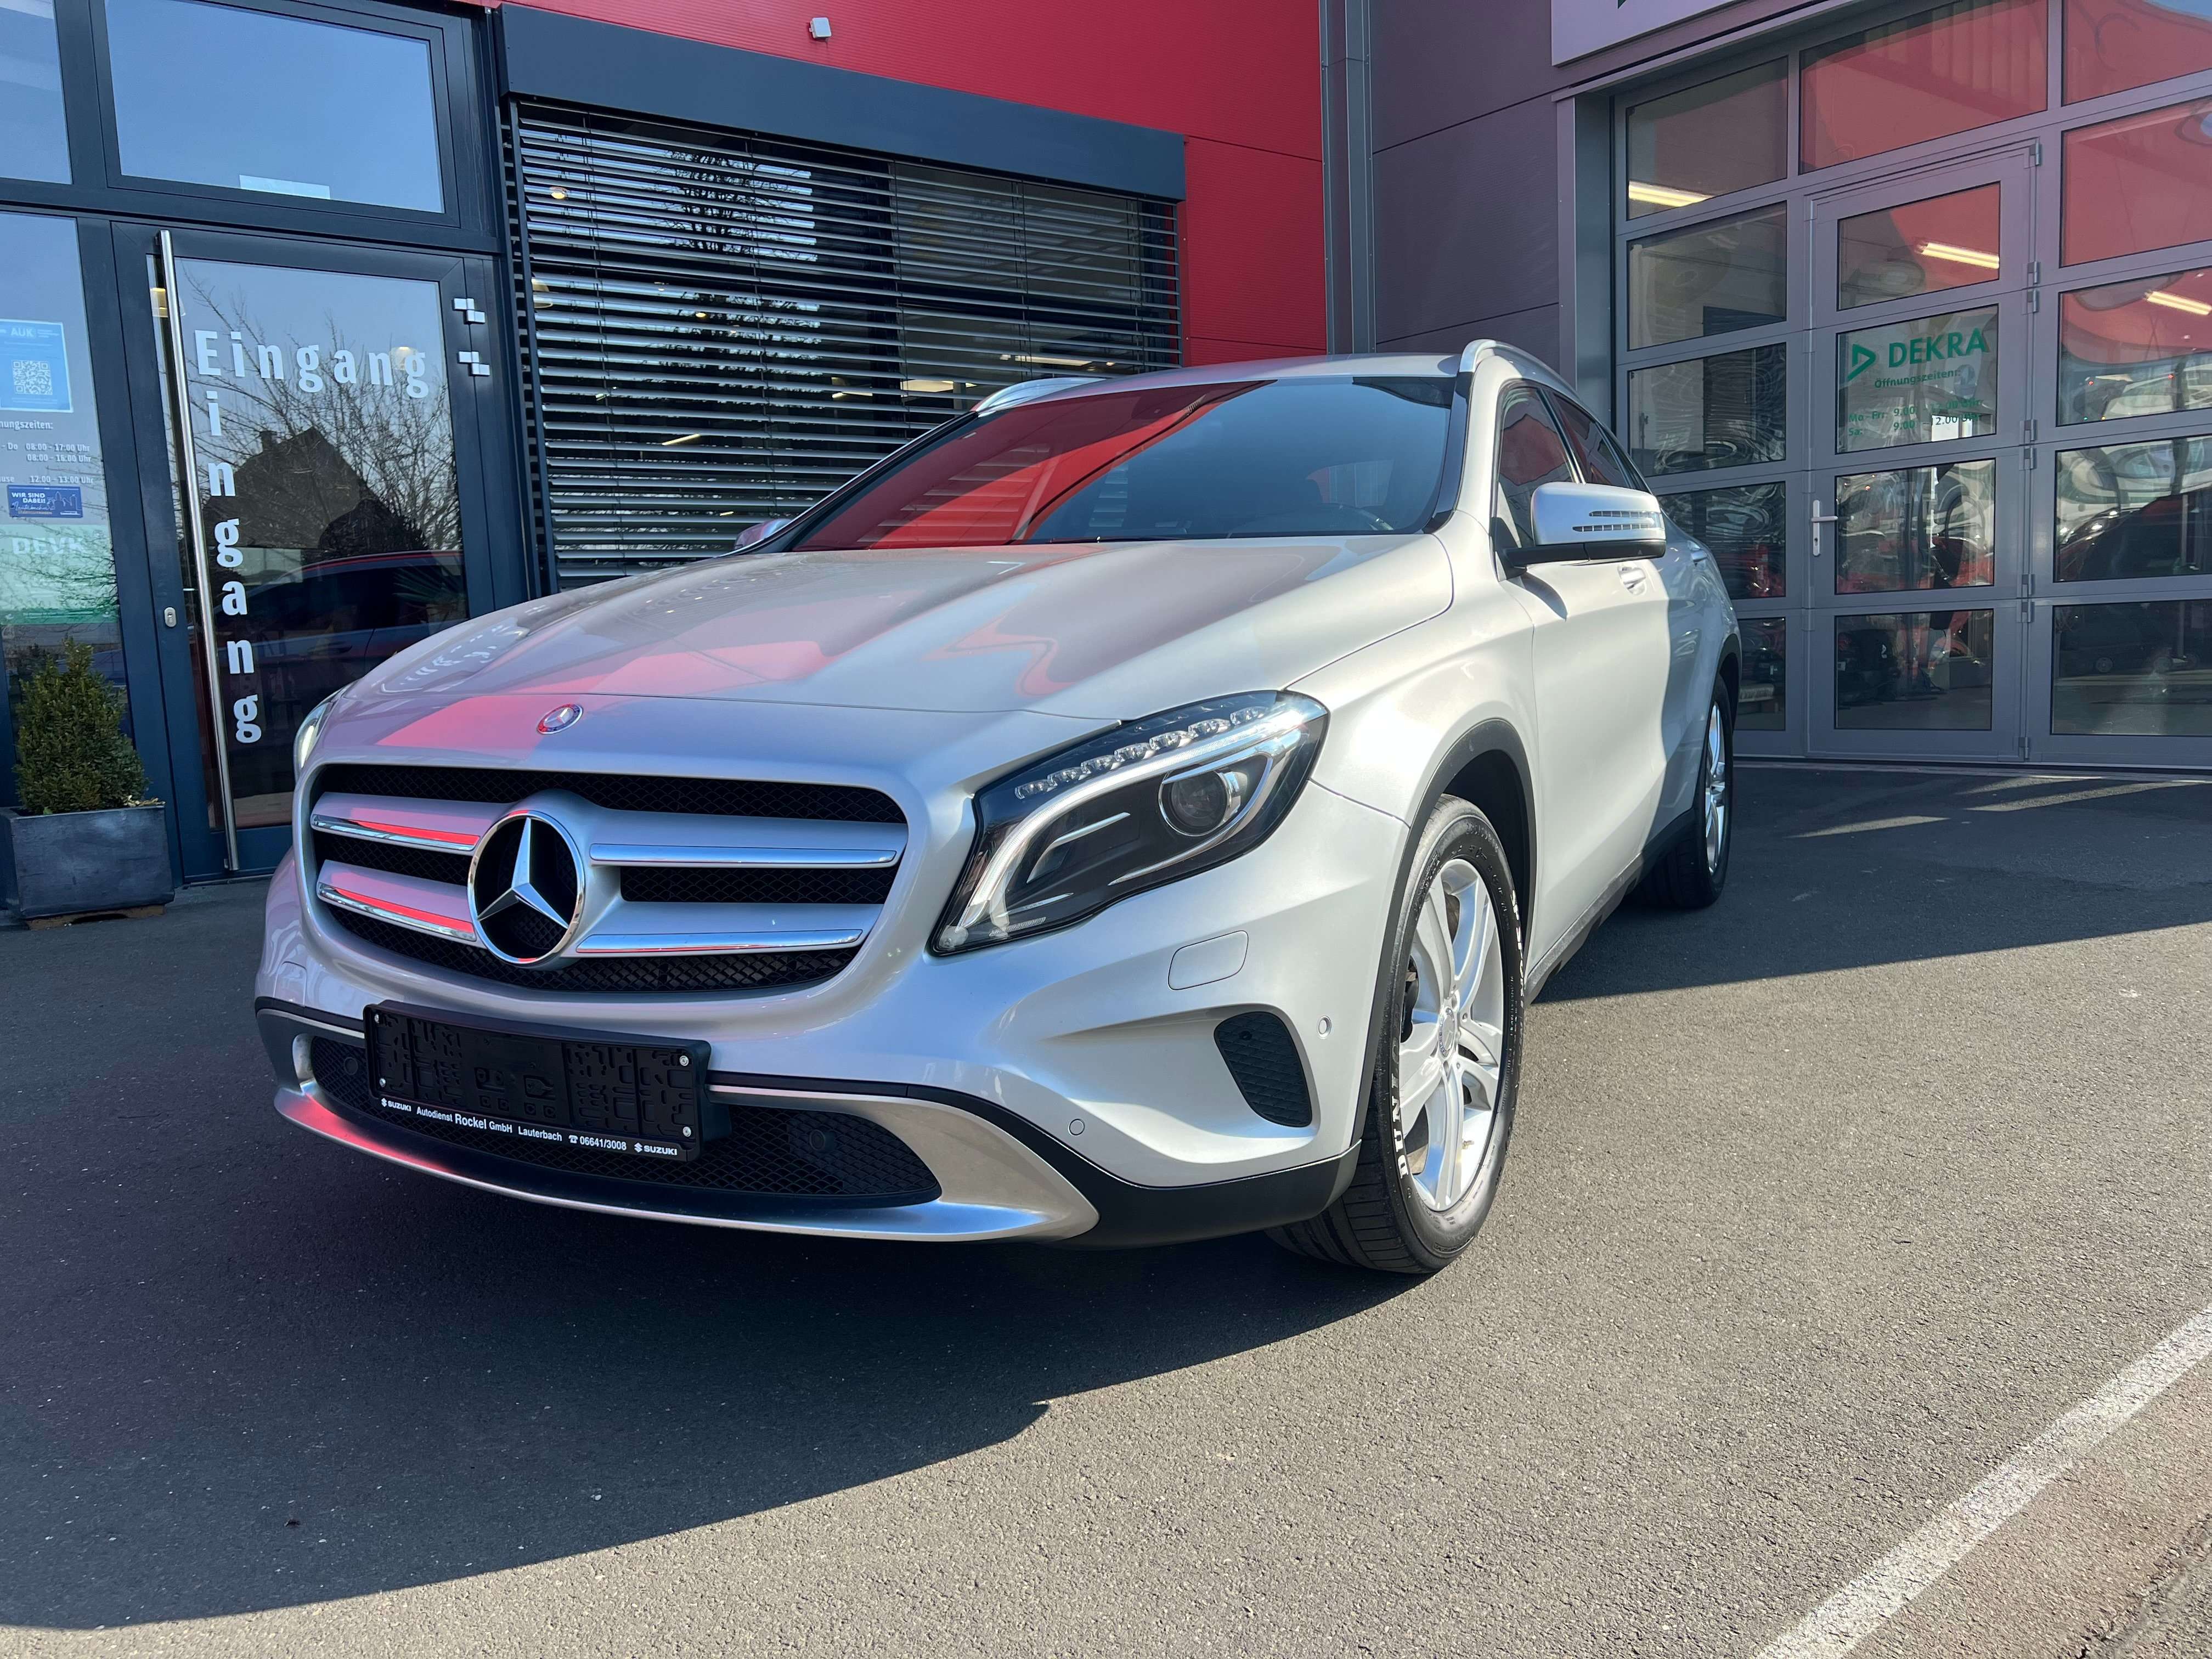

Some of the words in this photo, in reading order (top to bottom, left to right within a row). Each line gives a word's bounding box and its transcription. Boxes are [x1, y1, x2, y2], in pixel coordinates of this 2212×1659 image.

[195, 329, 428, 399] Eingang
[1888, 328, 1988, 368] DEKRA
[7, 442, 18, 450] Do
[77, 444, 91, 452] Uhr
[81, 476, 94, 484] Uhr
[387, 1100, 411, 1112] SUZUKI
[416, 1106, 453, 1122] Autodienst
[455, 1113, 487, 1130] Rockel
[488, 1121, 513, 1133] GmbH
[518, 1126, 562, 1142] Lauterbach
[579, 1136, 627, 1151] 06641/3008
[644, 1144, 678, 1156] SUZUKI
